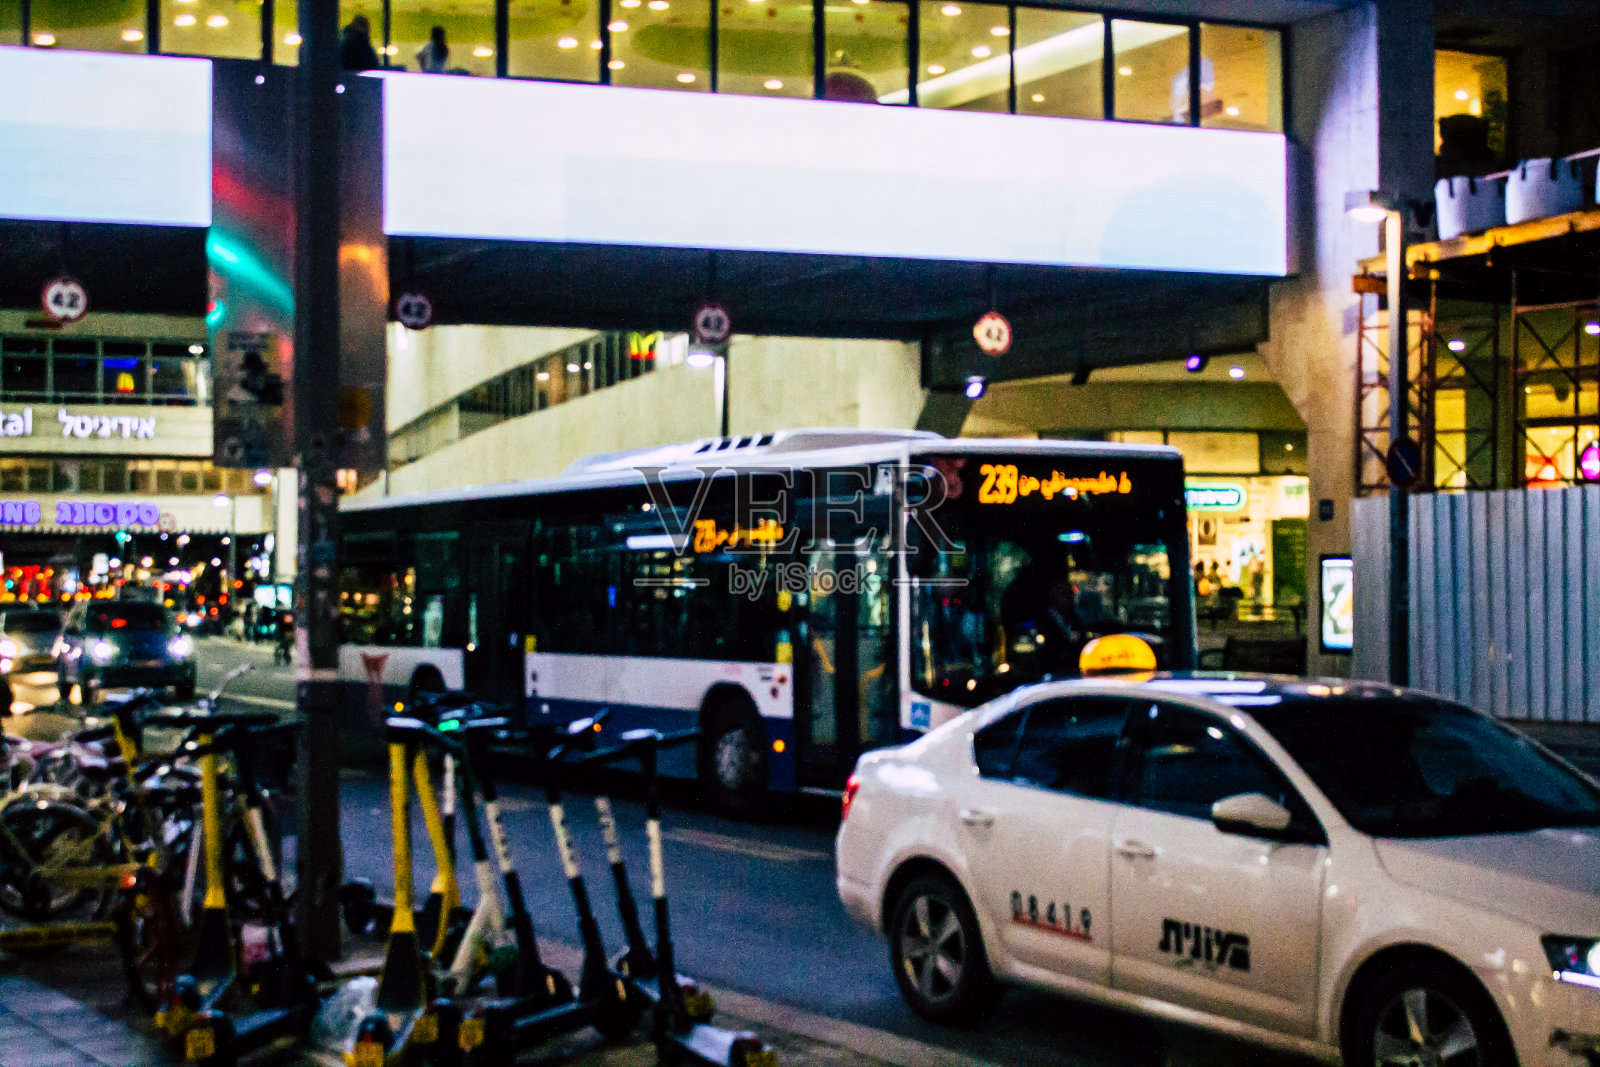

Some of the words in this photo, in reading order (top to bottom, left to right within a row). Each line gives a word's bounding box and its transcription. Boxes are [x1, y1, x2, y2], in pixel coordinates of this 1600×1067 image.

[58, 407, 156, 439] אידיגיטל
[978, 463, 1019, 504] 239
[0, 501, 42, 526] NG
[55, 501, 161, 527] סמסונג
